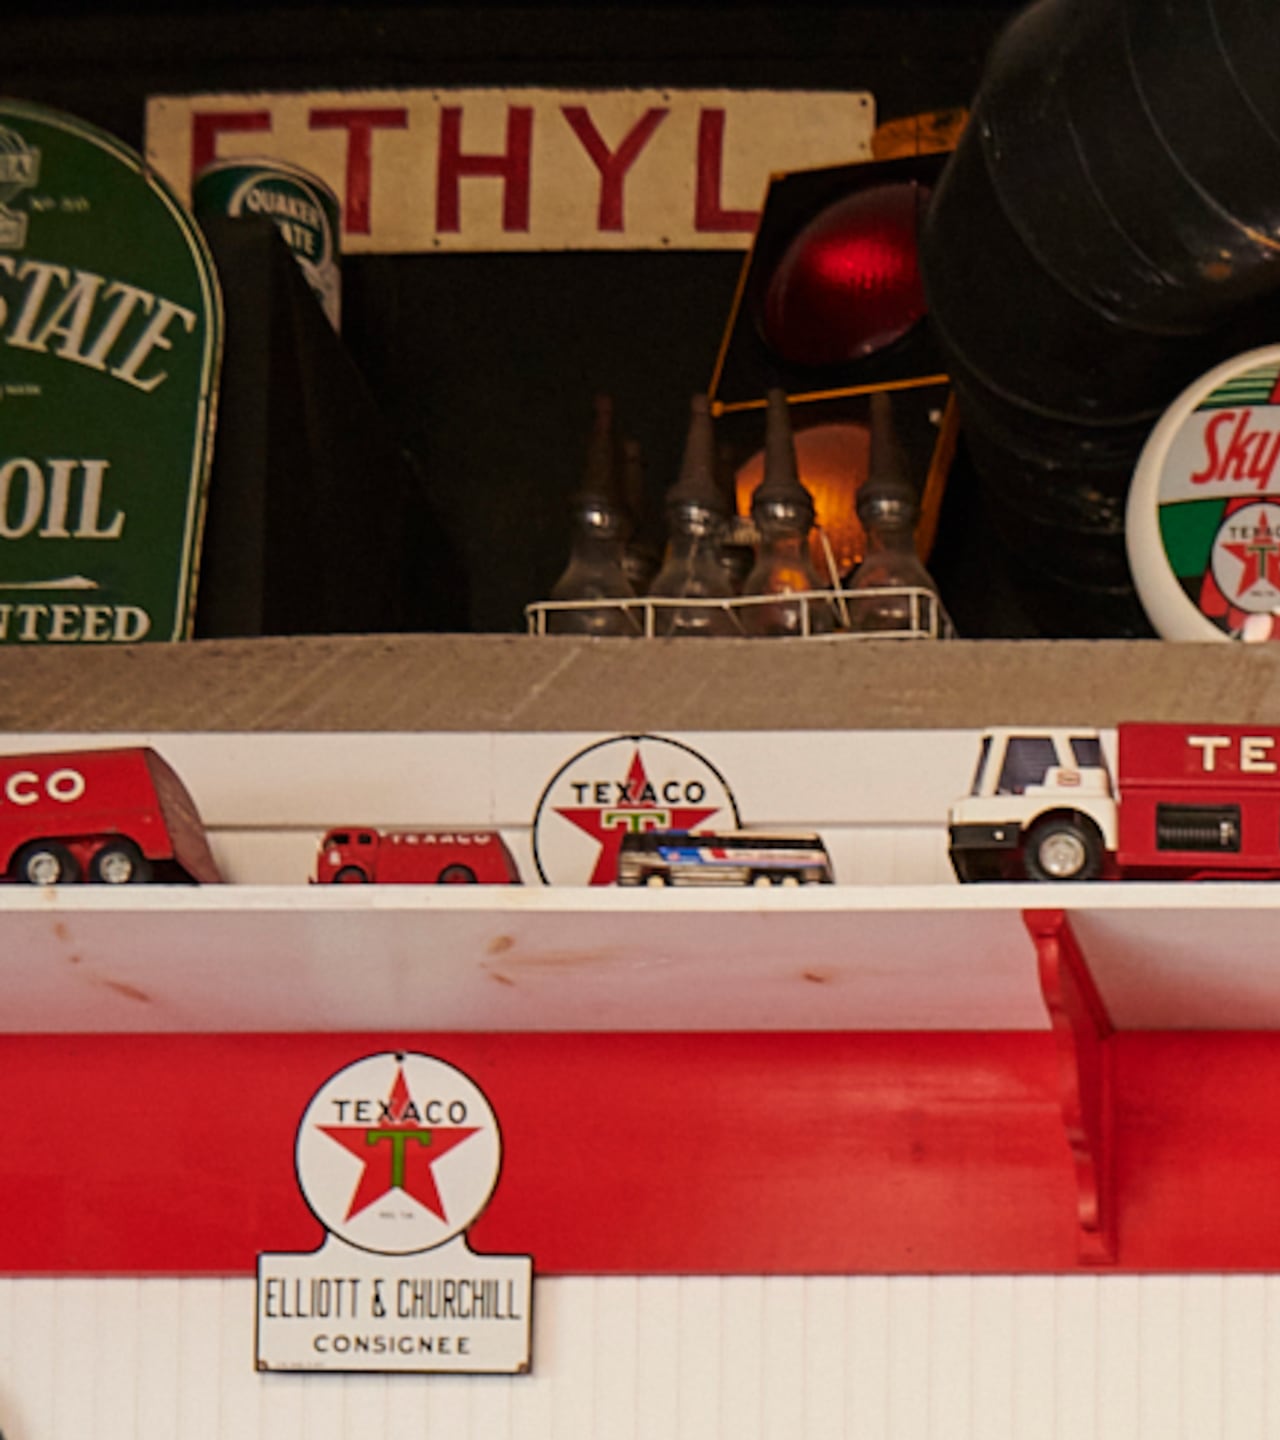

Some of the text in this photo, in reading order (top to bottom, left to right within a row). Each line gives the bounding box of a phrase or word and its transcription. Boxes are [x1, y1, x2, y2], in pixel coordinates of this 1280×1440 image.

[0, 255, 197, 392] TATE
[570, 780, 706, 806] TEXACO
[331, 1099, 469, 1125] TEXACO
[265, 1278, 522, 1320] ELLIOTT & CHURCHILL
[313, 1335, 471, 1356] CONSIGNEE
